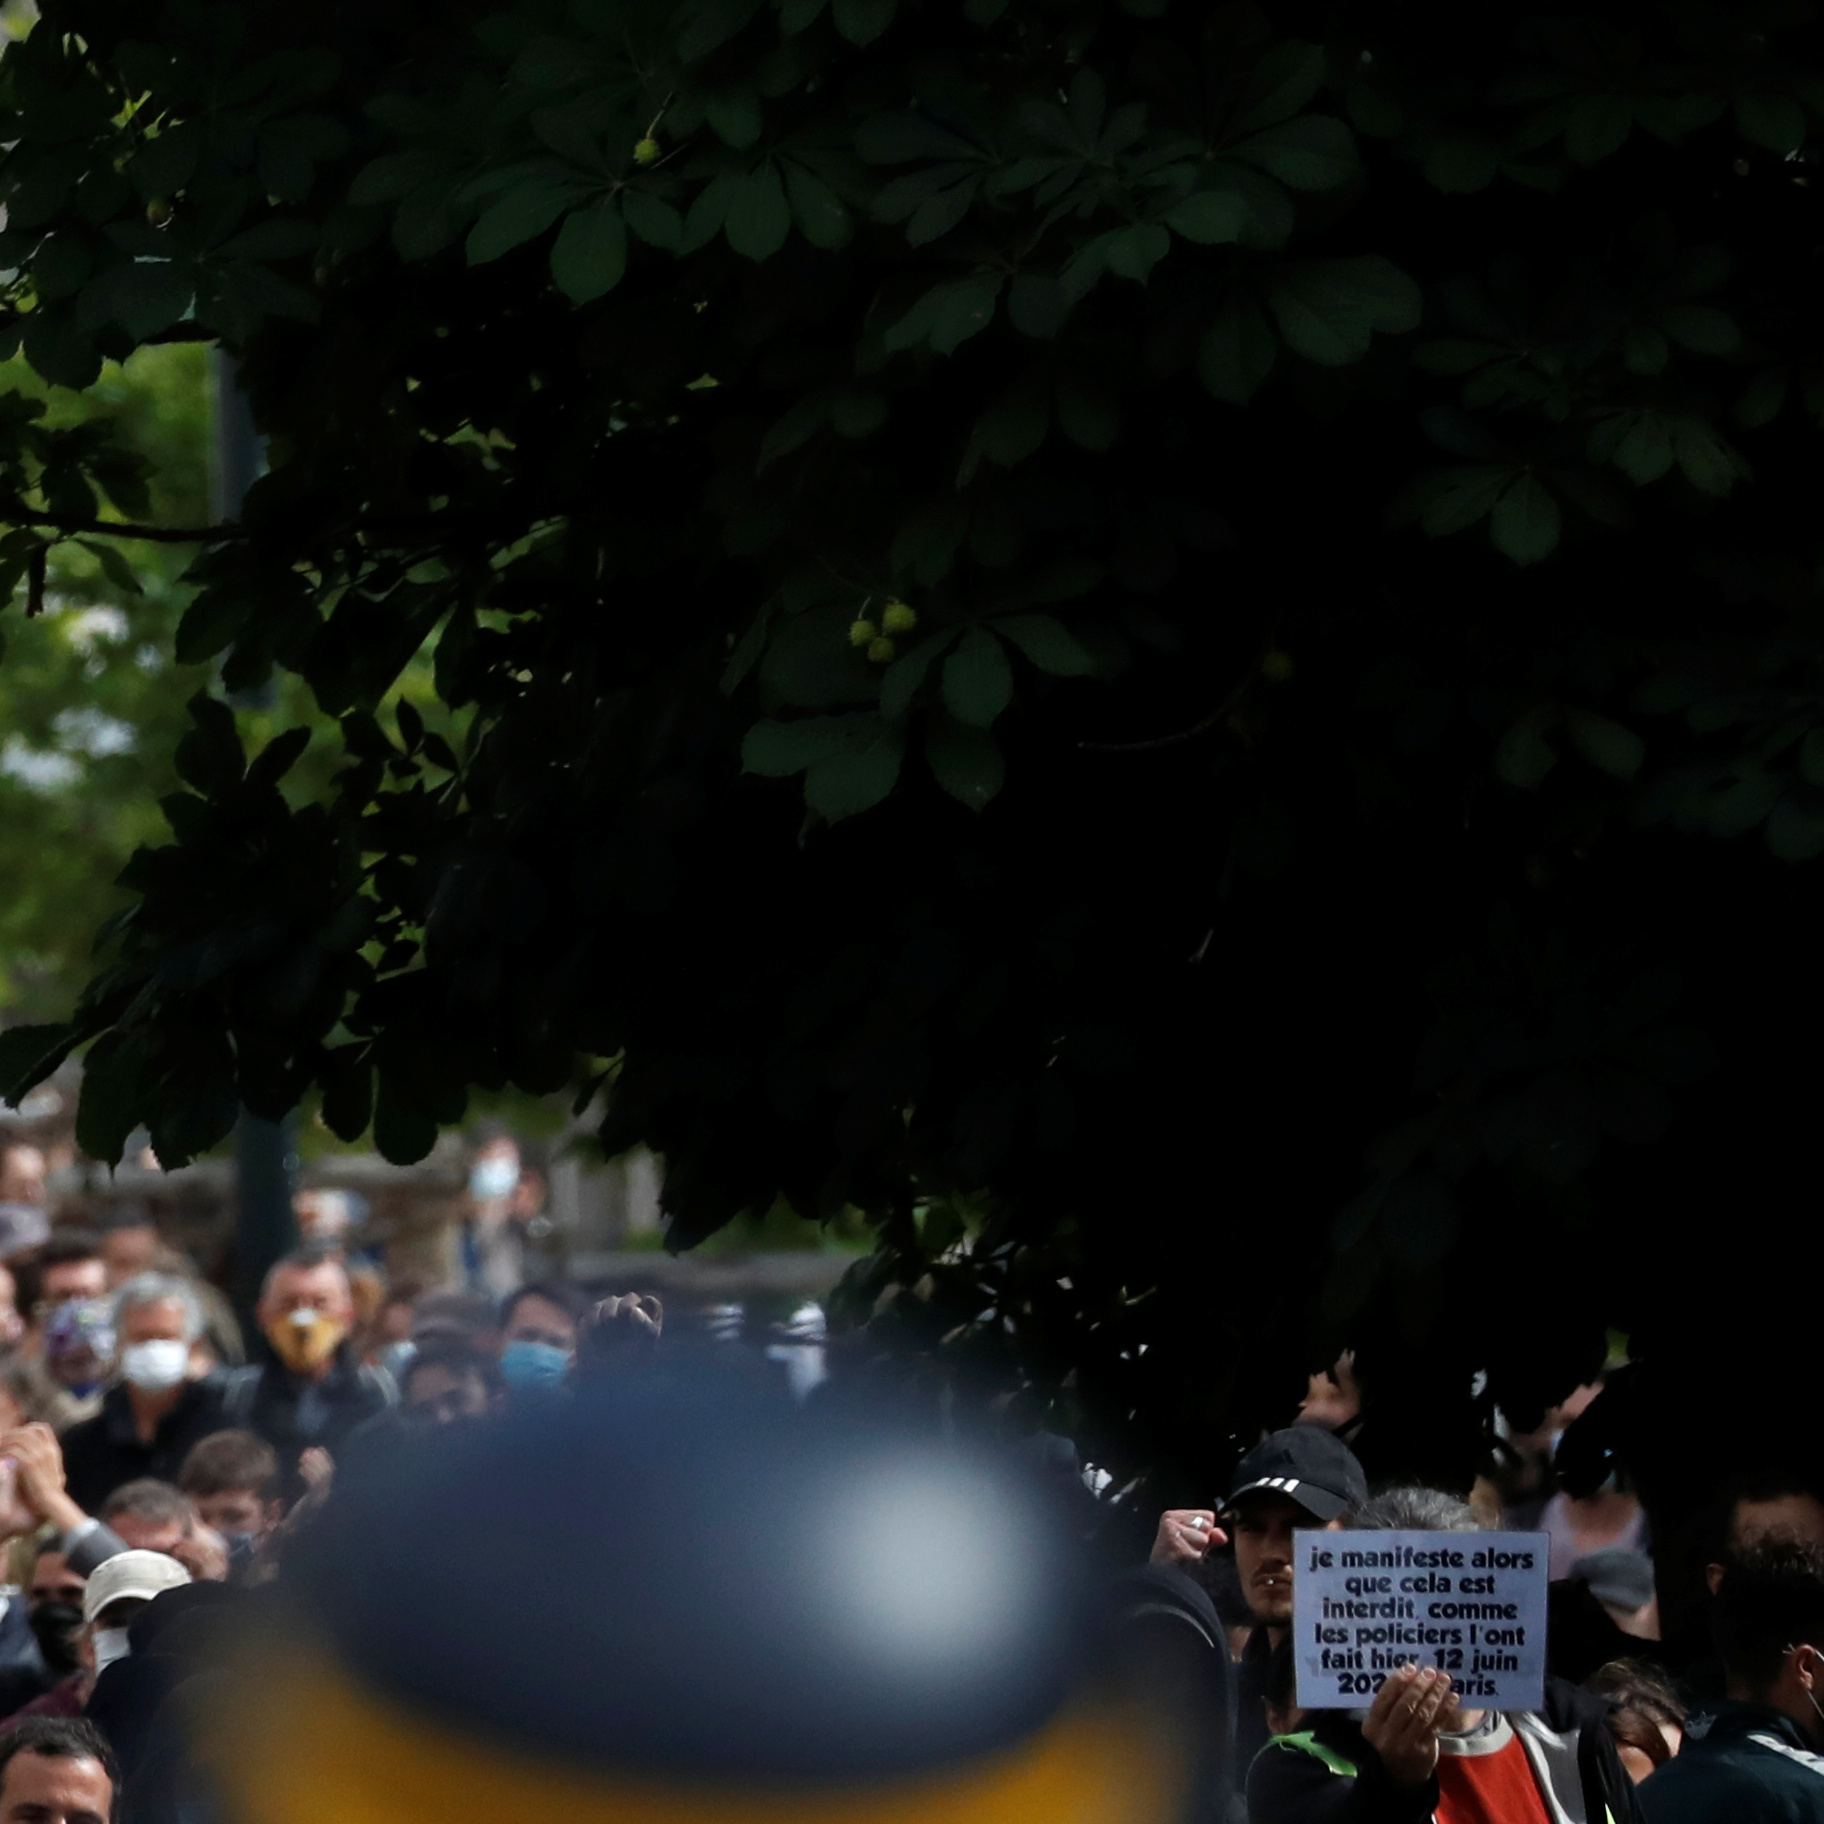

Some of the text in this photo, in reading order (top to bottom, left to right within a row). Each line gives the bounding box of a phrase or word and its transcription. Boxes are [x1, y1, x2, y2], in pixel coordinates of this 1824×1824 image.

[1309, 1545, 1534, 1572] je manifeste alors
[1345, 1571, 1496, 1598] que cela est
[1427, 1602, 1519, 1620] comme
[1314, 1622, 1526, 1648] les policiers l'ont
[1321, 1647, 1364, 1670] fait
[1433, 1648, 1464, 1670] 12
[1470, 1649, 1519, 1675] juin
